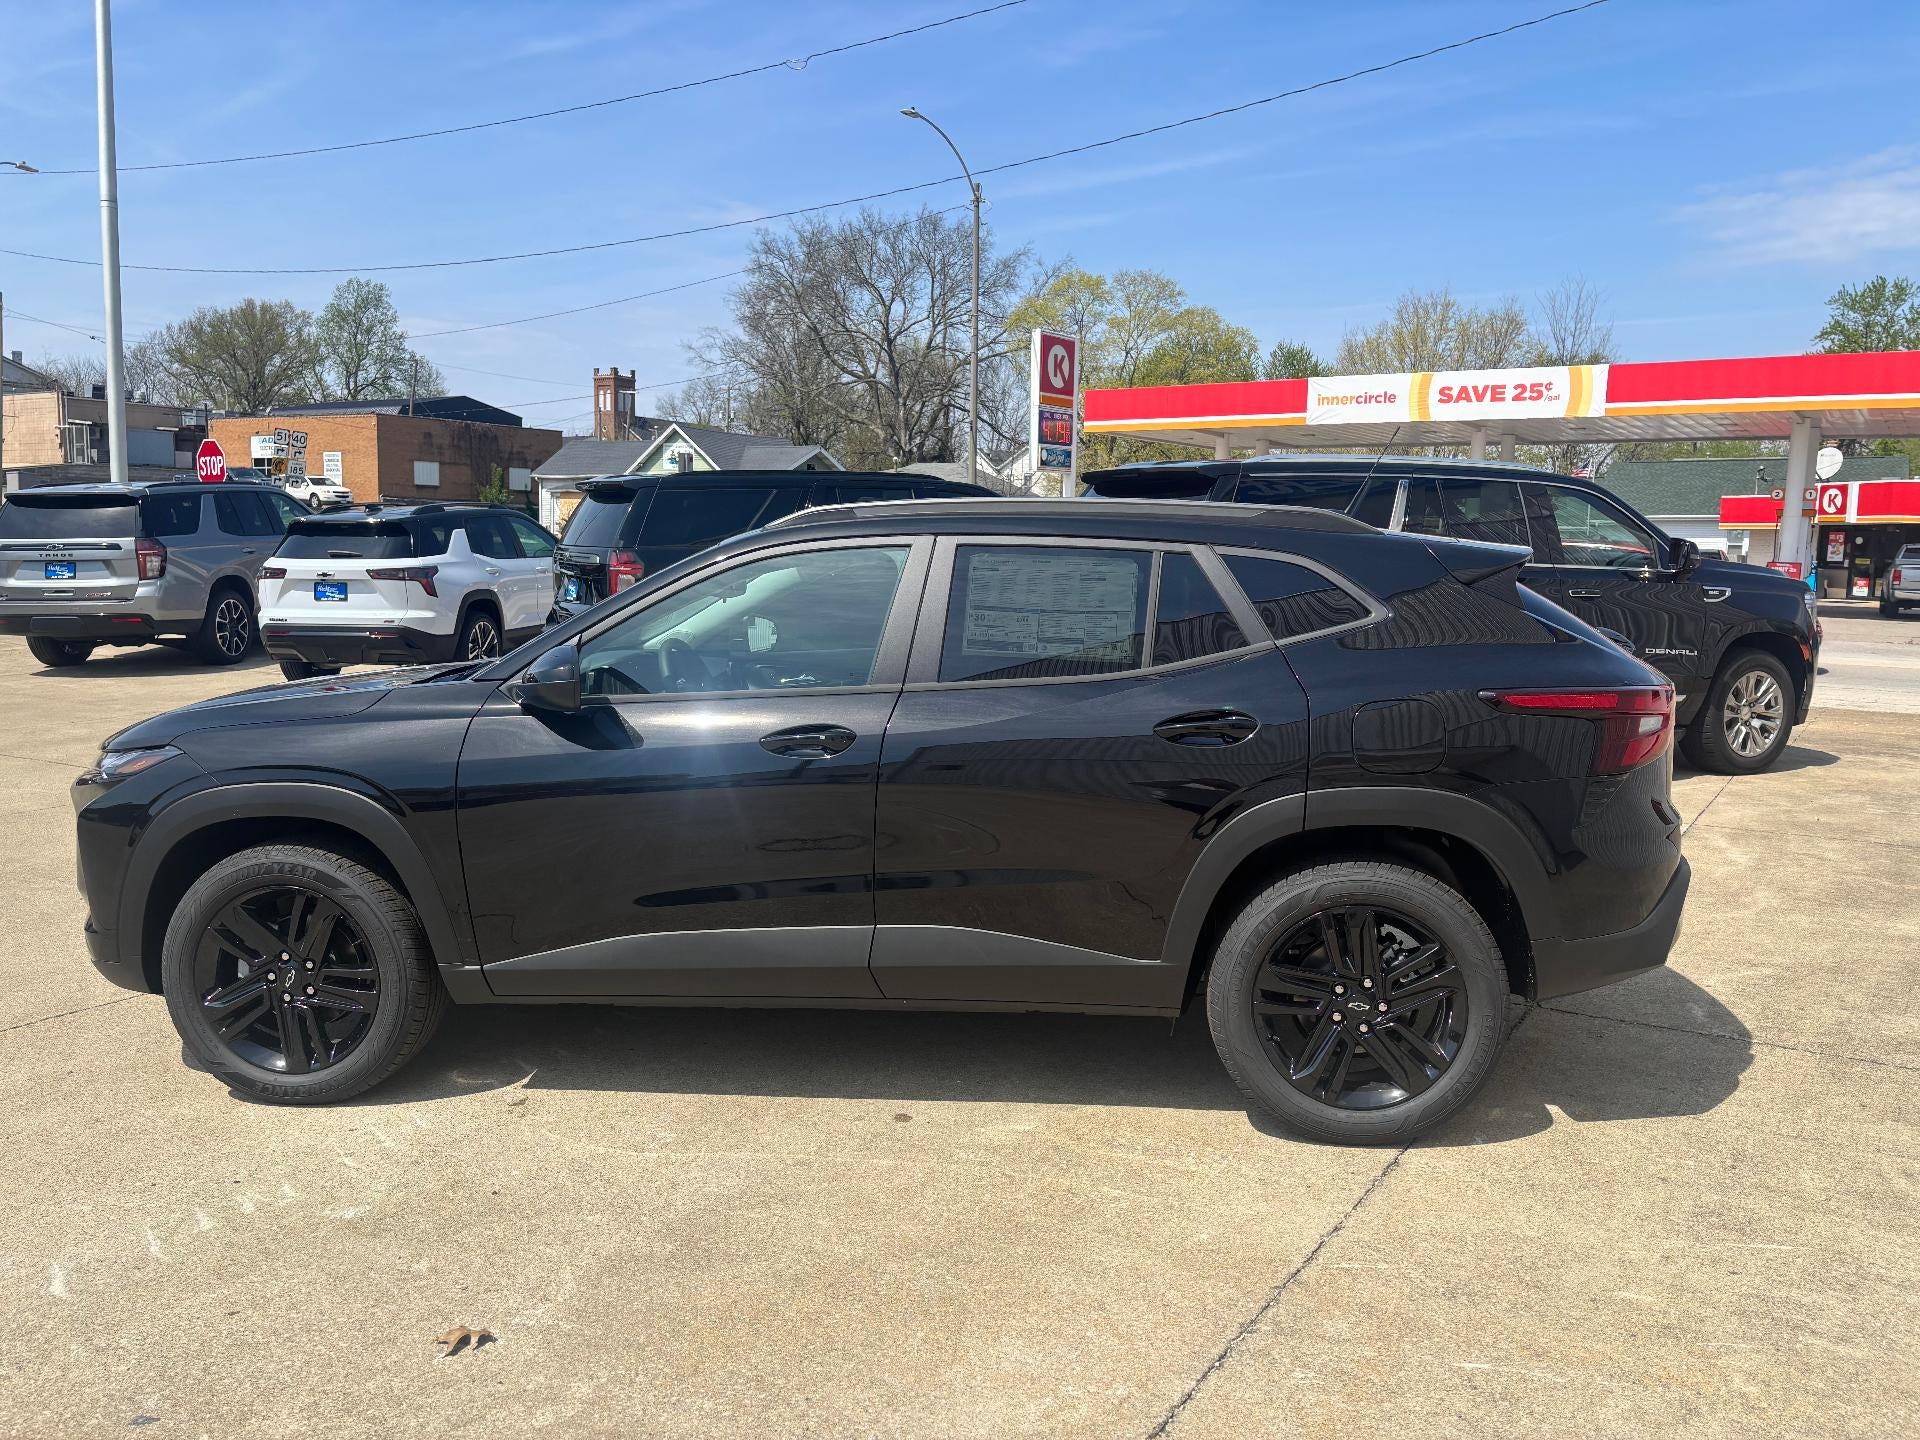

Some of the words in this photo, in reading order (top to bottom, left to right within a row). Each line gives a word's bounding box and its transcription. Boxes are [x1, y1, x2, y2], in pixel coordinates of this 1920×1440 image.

[1053, 353, 1067, 386] K
[1317, 390, 1397, 406] innercircle
[1438, 384, 1507, 404] SAVE
[276, 431, 287, 442] 51
[292, 434, 306, 445] 40
[199, 455, 224, 476] STOP
[289, 466, 304, 475] 185
[1828, 493, 1839, 510] K
[1645, 648, 1698, 656] DENALI
